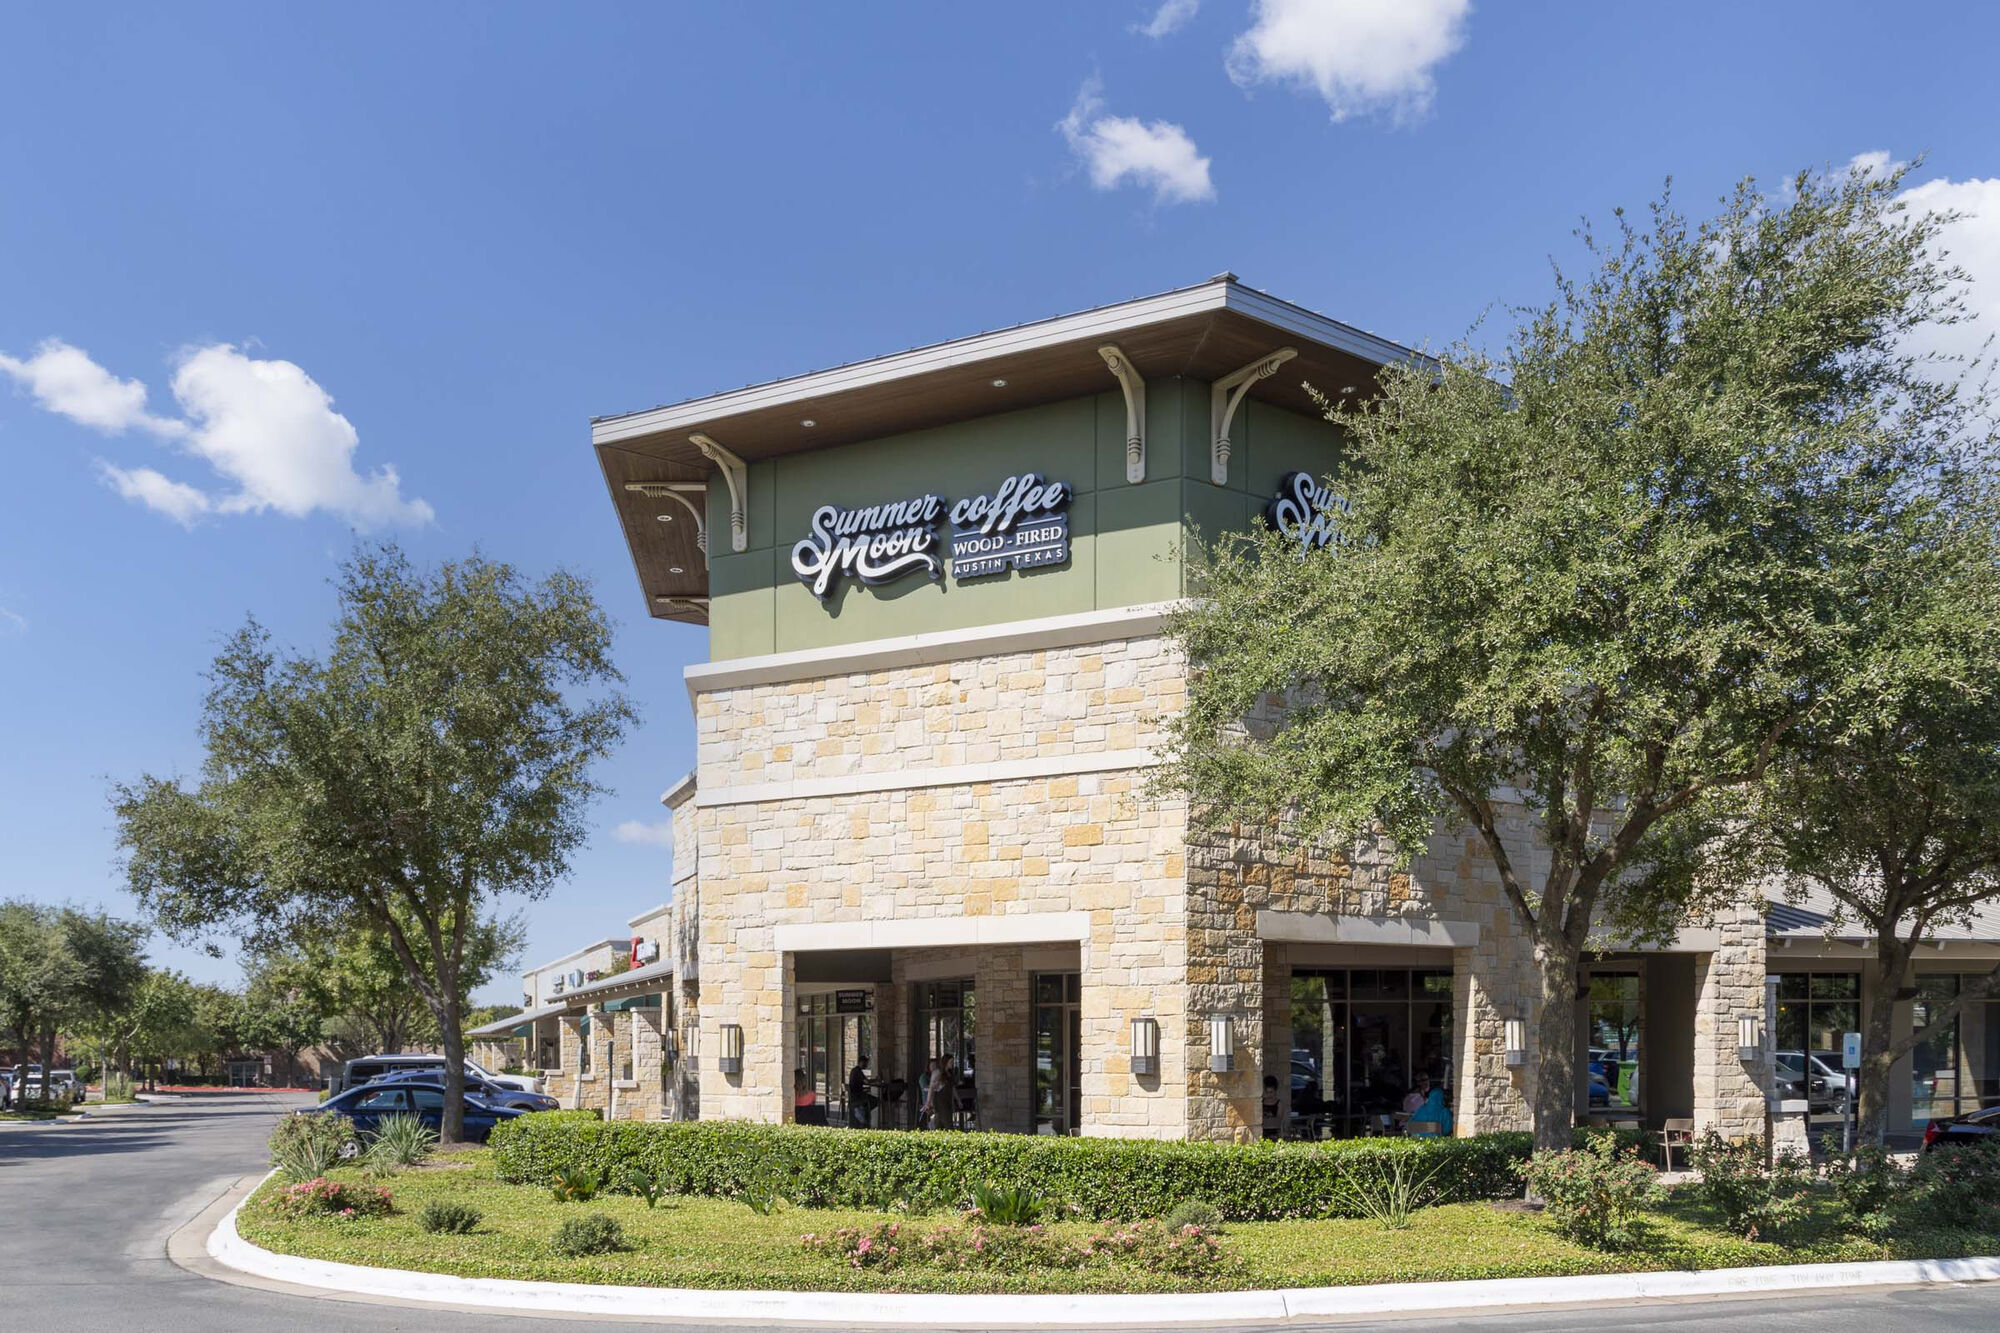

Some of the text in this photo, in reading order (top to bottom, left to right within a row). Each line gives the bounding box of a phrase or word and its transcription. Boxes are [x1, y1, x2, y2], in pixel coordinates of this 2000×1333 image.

[791, 494, 940, 575] Summer
[949, 473, 1064, 534] coffee
[814, 527, 934, 595] Moon
[954, 549, 1063, 574] AUSTIN TEXAS
